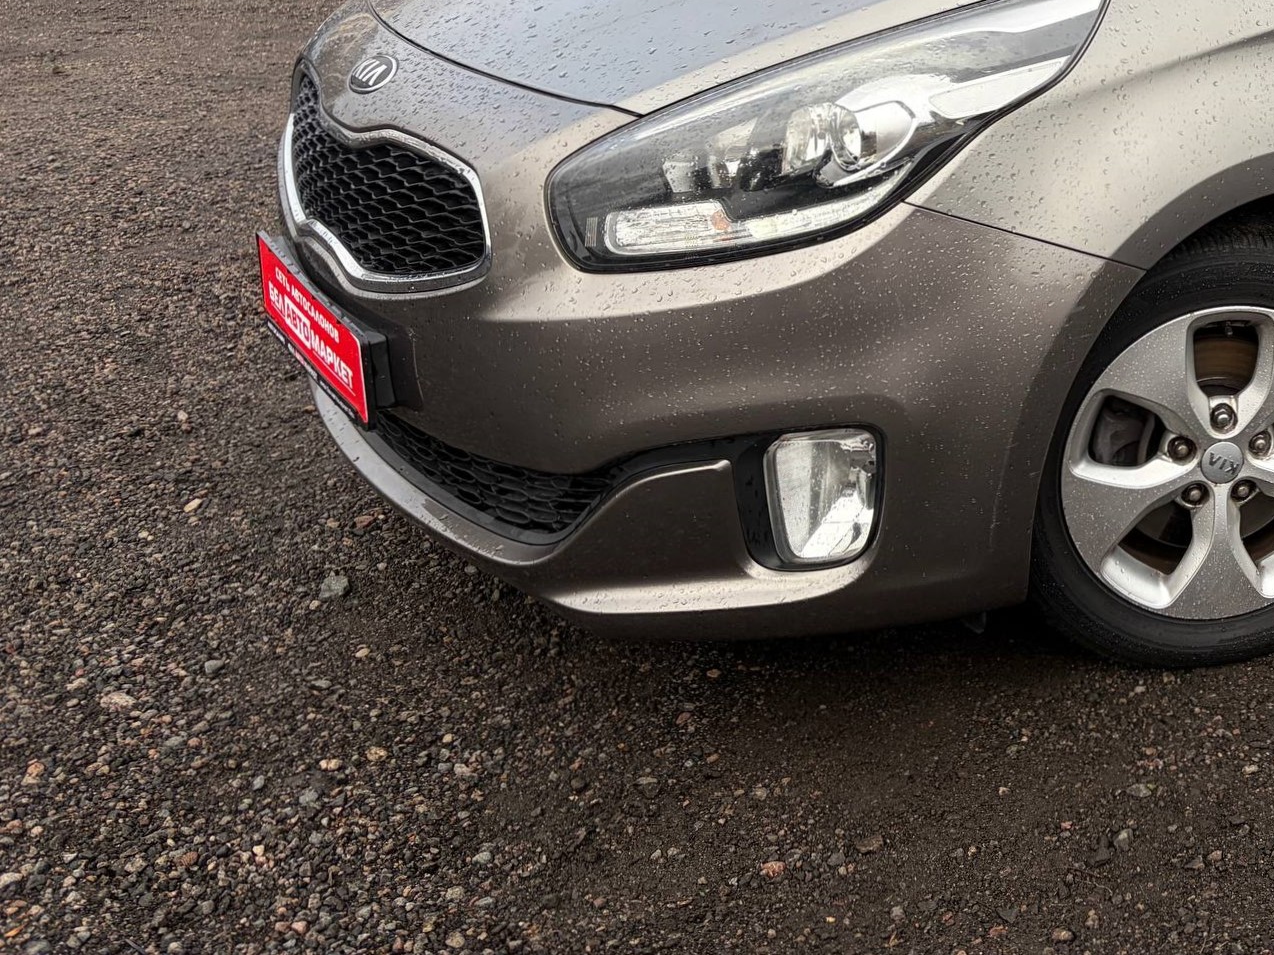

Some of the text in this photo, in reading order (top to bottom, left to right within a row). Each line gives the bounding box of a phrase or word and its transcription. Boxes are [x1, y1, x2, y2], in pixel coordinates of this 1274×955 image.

[268, 280, 286, 316] БЕЛ
[285, 298, 311, 346] АВТО
[310, 330, 354, 390] МАРКЕТ
[275, 267, 291, 292] СЕТЬ
[291, 285, 340, 344] АВТОСАЛОНОВ
